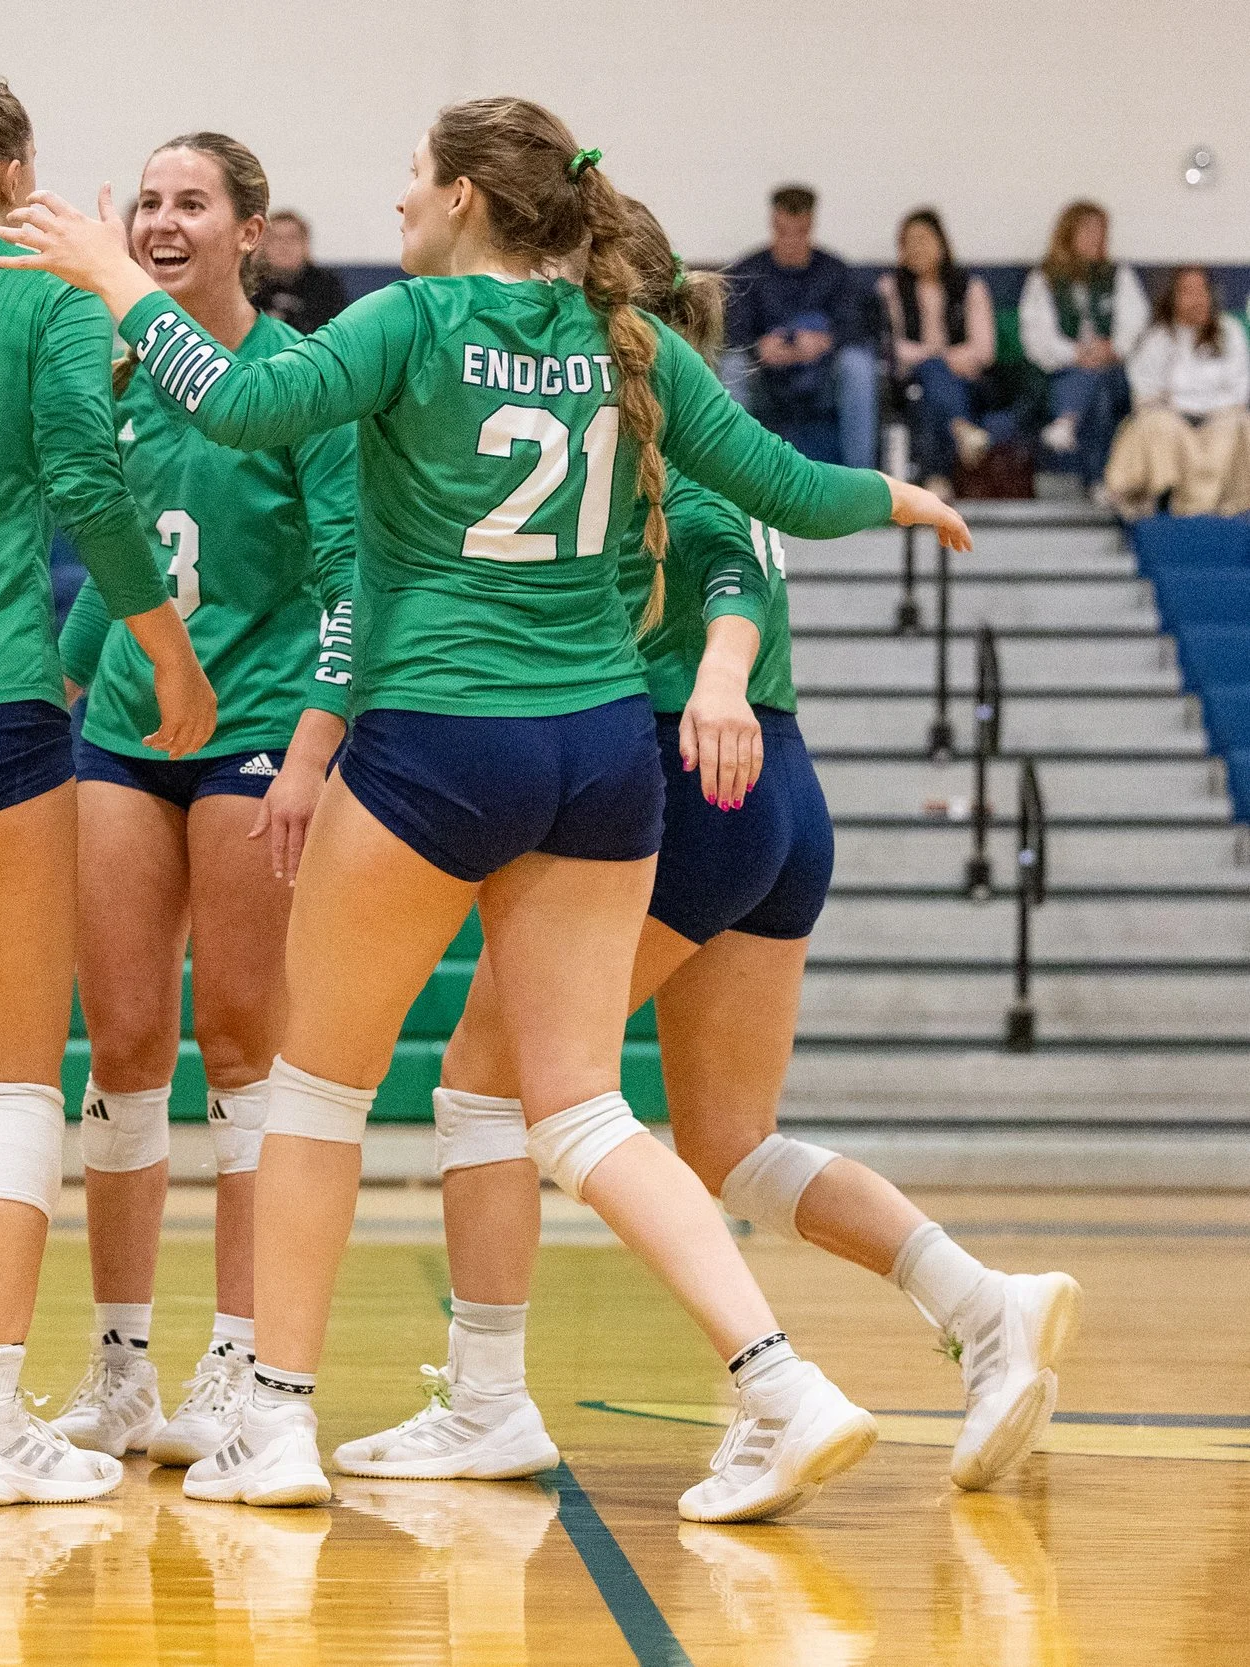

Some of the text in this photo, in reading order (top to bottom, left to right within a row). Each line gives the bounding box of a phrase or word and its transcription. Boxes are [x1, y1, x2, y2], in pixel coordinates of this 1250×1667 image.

[135, 310, 233, 415] GULLS
[461, 403, 620, 563] 21
[154, 508, 201, 621] 3
[239, 766, 279, 777] adidas
